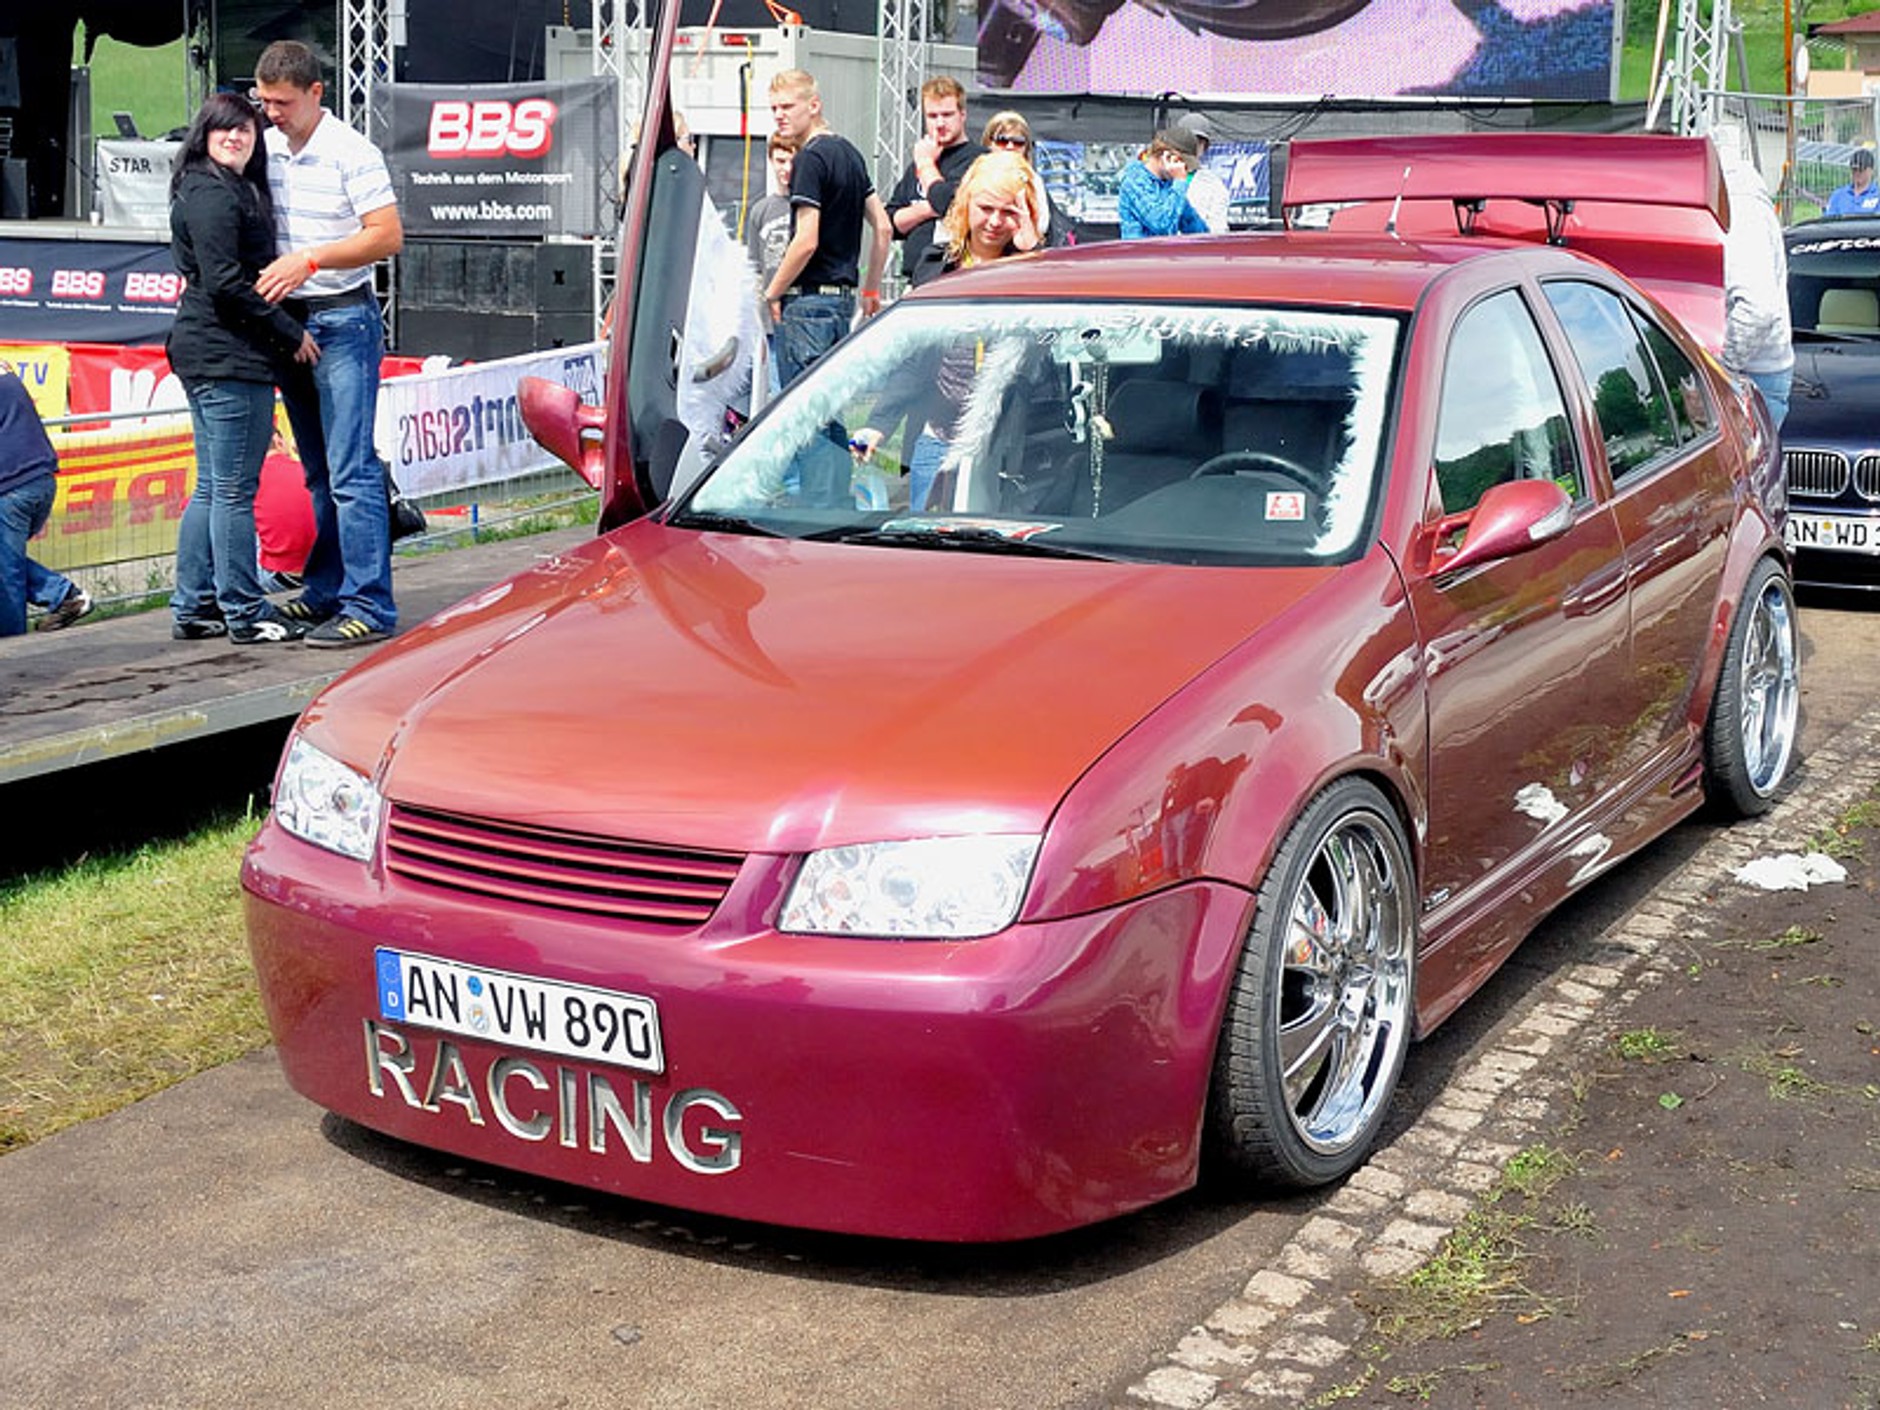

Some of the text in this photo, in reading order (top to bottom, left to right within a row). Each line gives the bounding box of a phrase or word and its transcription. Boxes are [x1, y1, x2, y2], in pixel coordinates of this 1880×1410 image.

[427, 98, 558, 159] BBS
[109, 157, 152, 173] STAR
[411, 172, 573, 185] Technik aus dem Motorsport
[430, 200, 552, 221] www.bbs.com
[0, 268, 180, 301] BS BBS BBS
[1835, 522, 1867, 546] WD
[386, 965, 652, 1061] D AN VW 890
[362, 1017, 742, 1175] RACING
